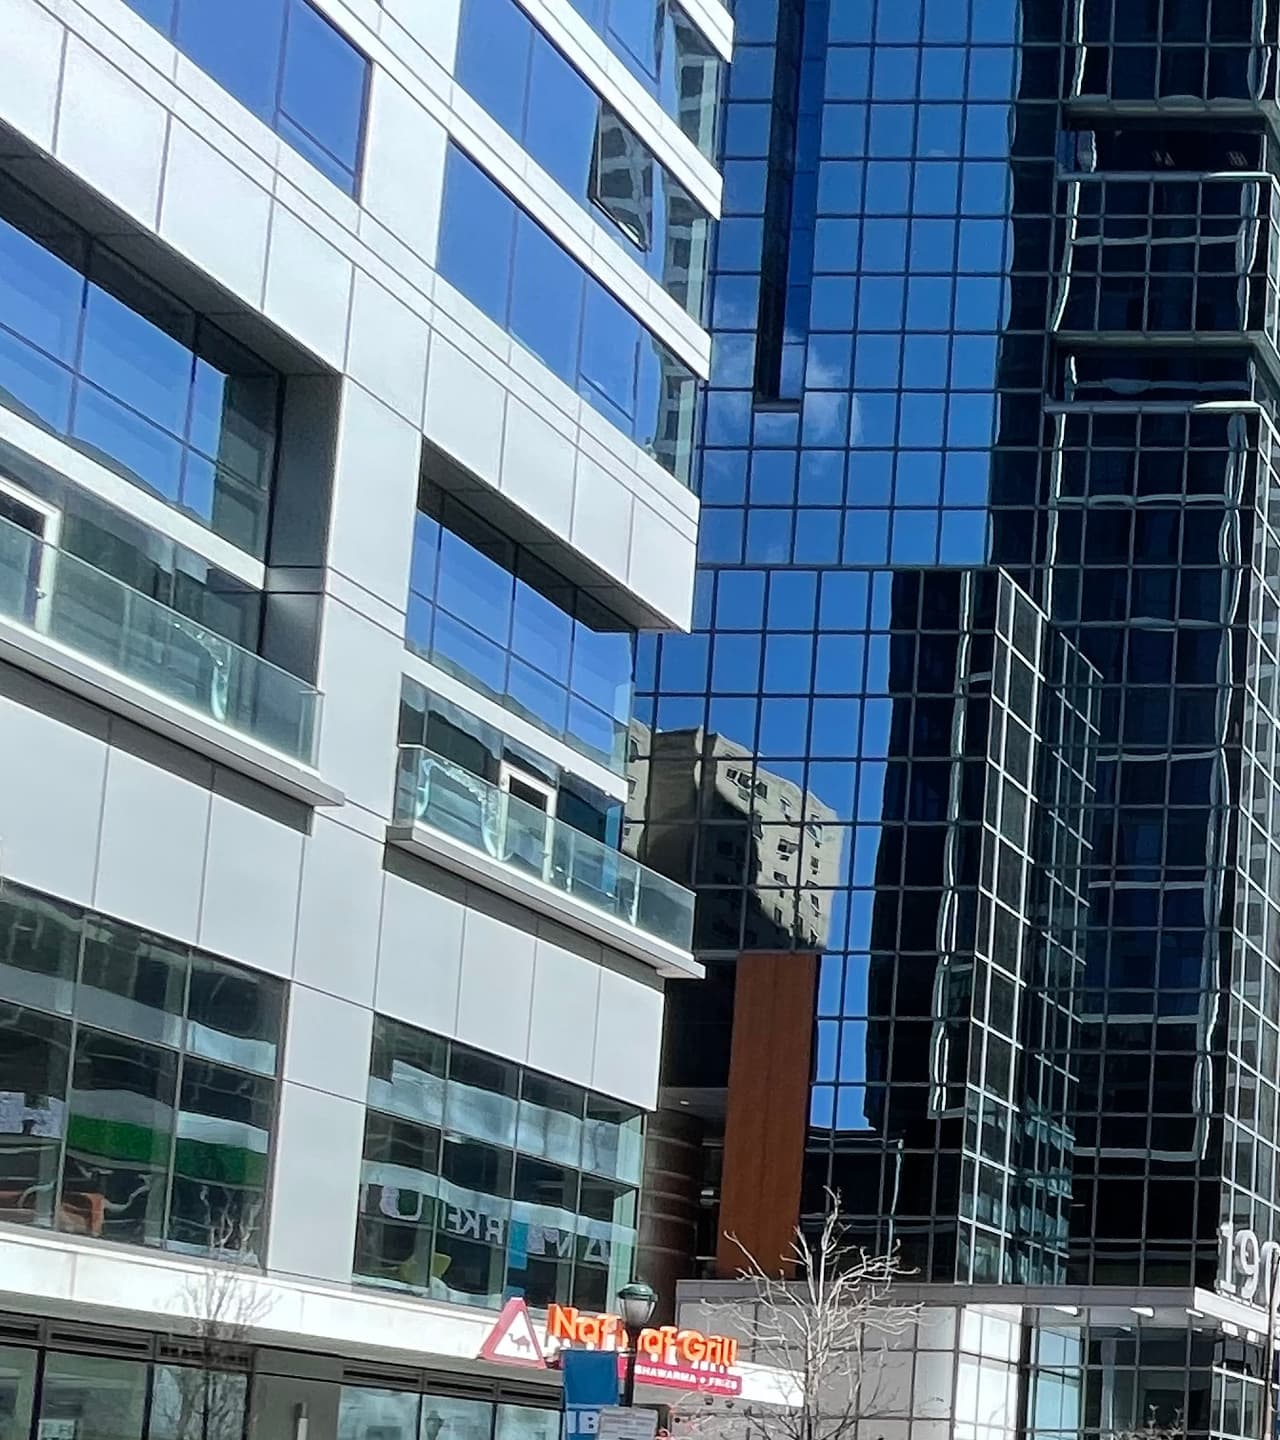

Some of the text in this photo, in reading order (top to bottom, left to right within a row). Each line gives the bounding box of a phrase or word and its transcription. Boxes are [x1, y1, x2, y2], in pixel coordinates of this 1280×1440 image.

[547, 1303, 622, 1349] Naf
[675, 1329, 738, 1368] Grill
[567, 1410, 599, 1434] IB
